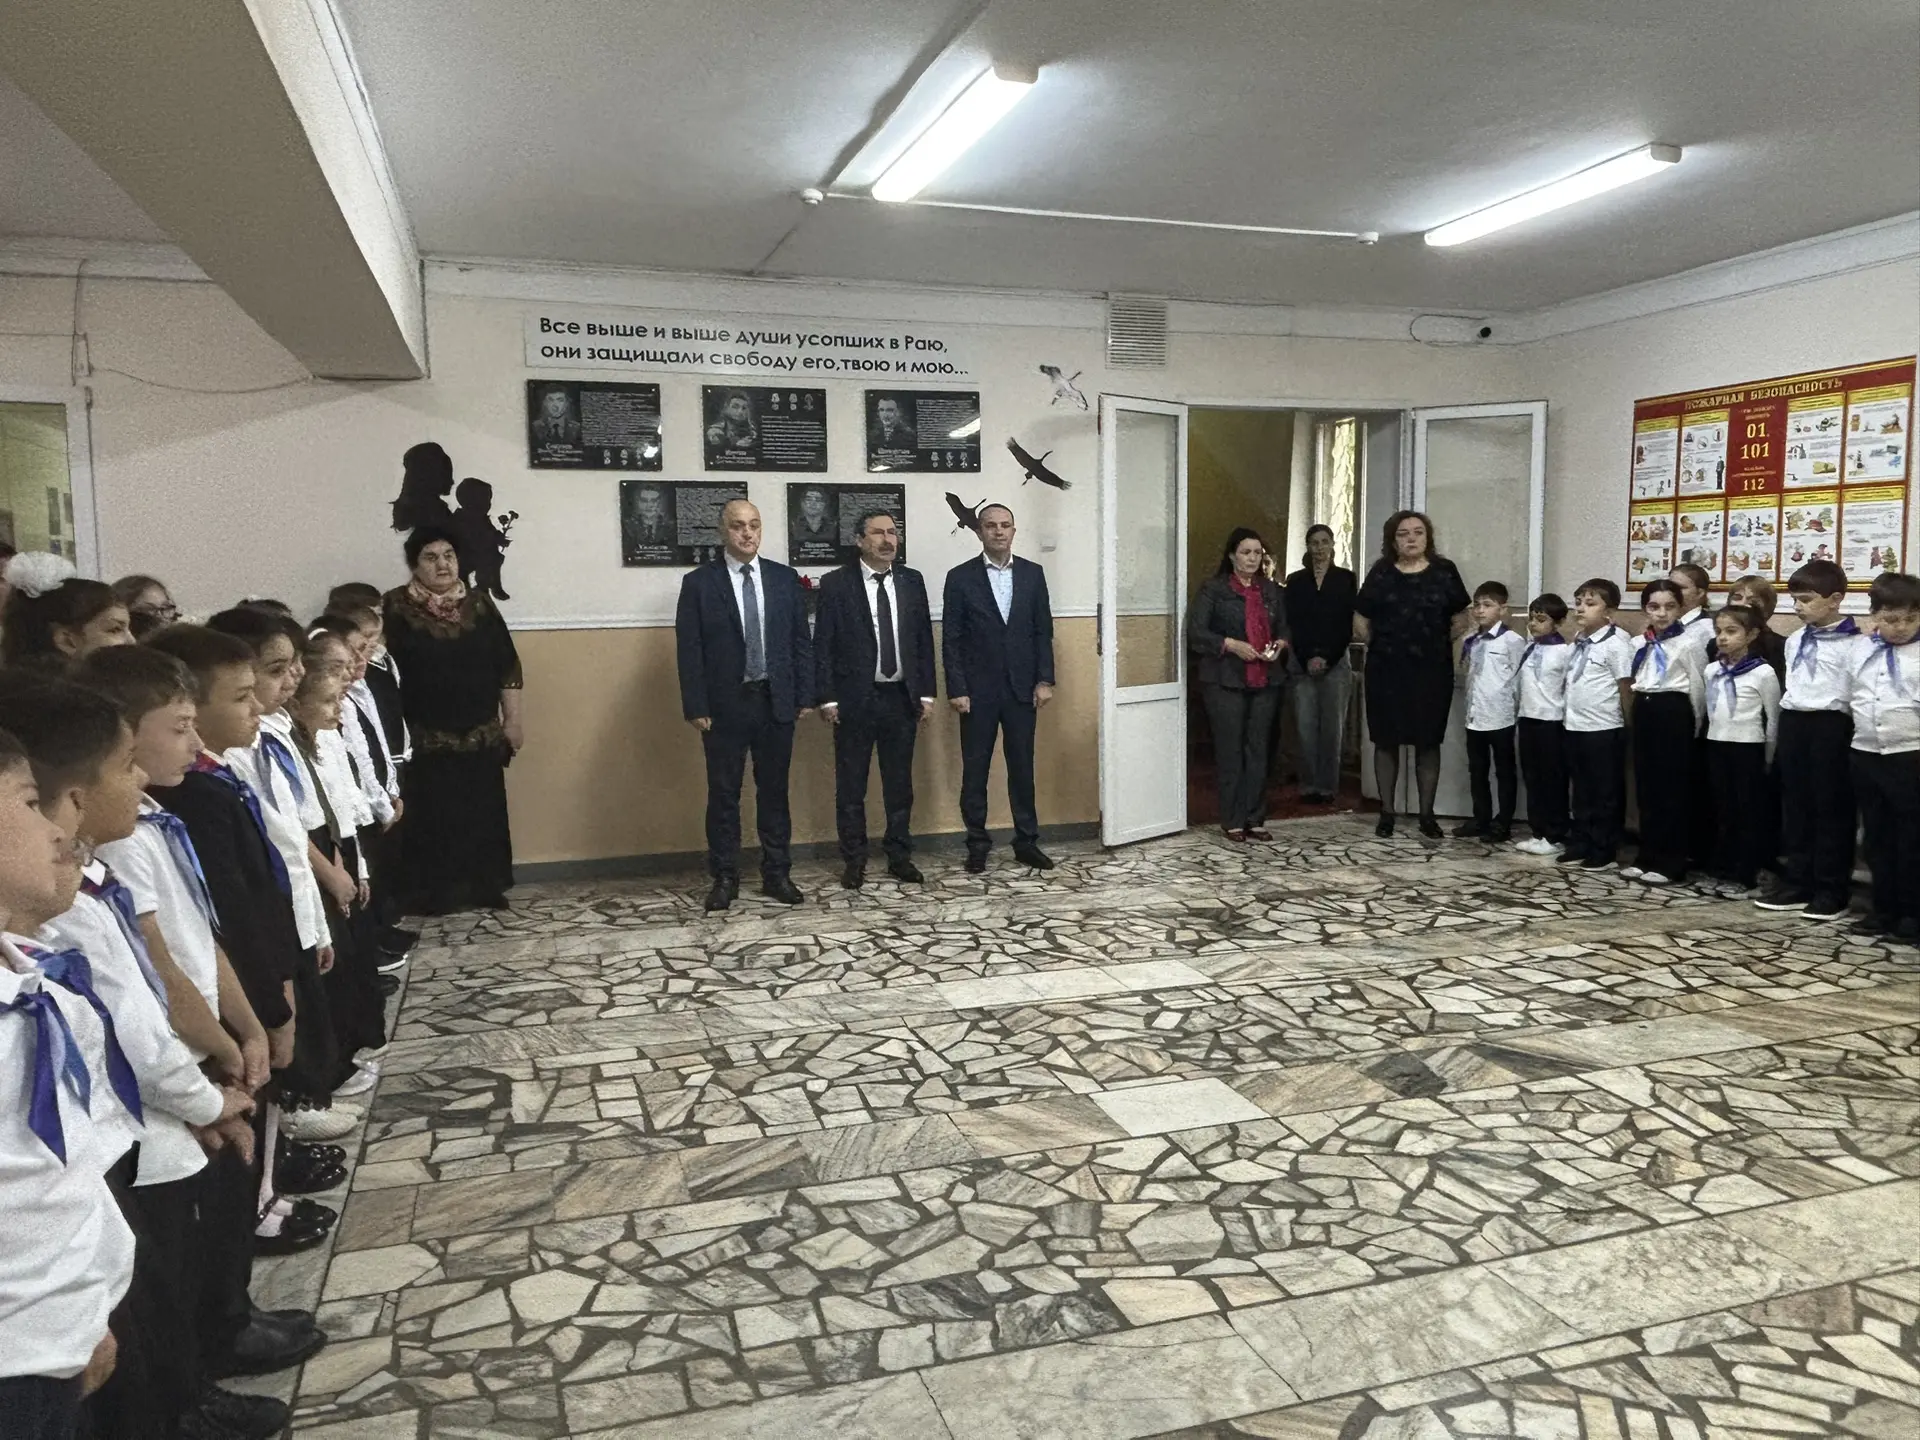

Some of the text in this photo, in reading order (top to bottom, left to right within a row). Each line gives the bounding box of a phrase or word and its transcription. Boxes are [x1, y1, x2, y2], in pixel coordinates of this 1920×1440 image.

[540, 317, 948, 353] Все выше и выше души усопших в Раю,
[541, 345, 581, 359] они
[587, 347, 704, 365] защищали
[709, 351, 797, 371] свободу
[895, 361, 907, 373] и
[910, 361, 969, 375] мою...
[1750, 378, 1842, 401] БЕЗОПАСНОСТЬ
[1740, 442, 1769, 459] 101
[1743, 478, 1765, 491] 112
